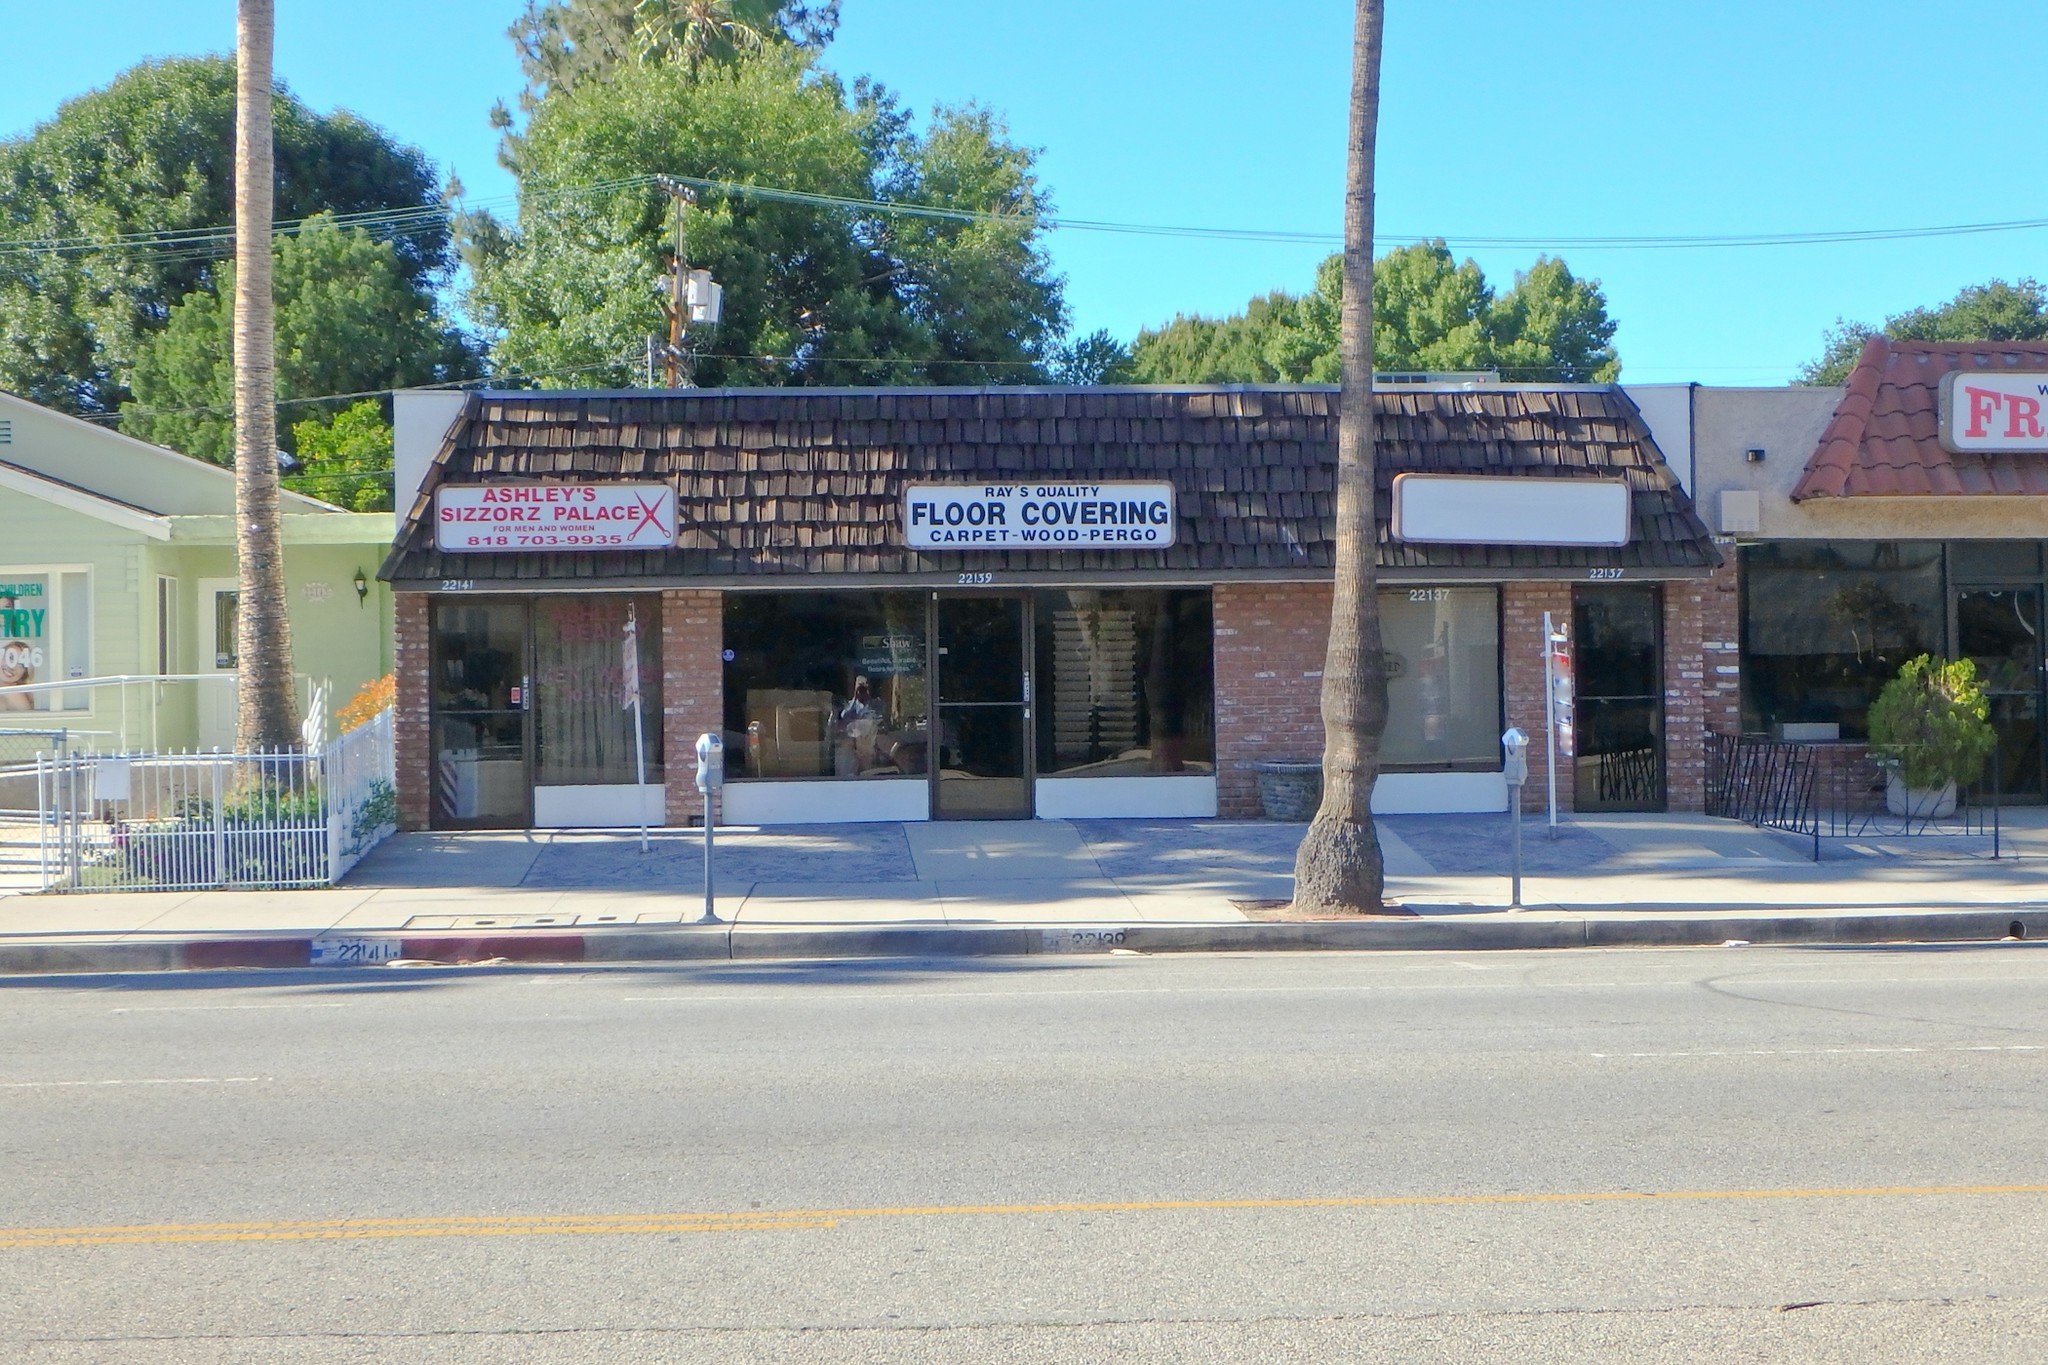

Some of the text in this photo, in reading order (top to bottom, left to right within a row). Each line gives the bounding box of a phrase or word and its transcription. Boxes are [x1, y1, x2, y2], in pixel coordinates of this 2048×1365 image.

[482, 487, 596, 503] ASHLEY'S
[984, 485, 1099, 498] RAY'S QUALITY
[440, 505, 641, 523] SIZZORZ PALACE
[912, 501, 1168, 526] FLOOR COVERING
[467, 534, 622, 546] 818 703-9935
[958, 572, 992, 584] 22139
[1590, 568, 1624, 579] 22137
[442, 579, 473, 591] 22141
[1409, 589, 1450, 601] 22137
[882, 636, 910, 649] Shaw
